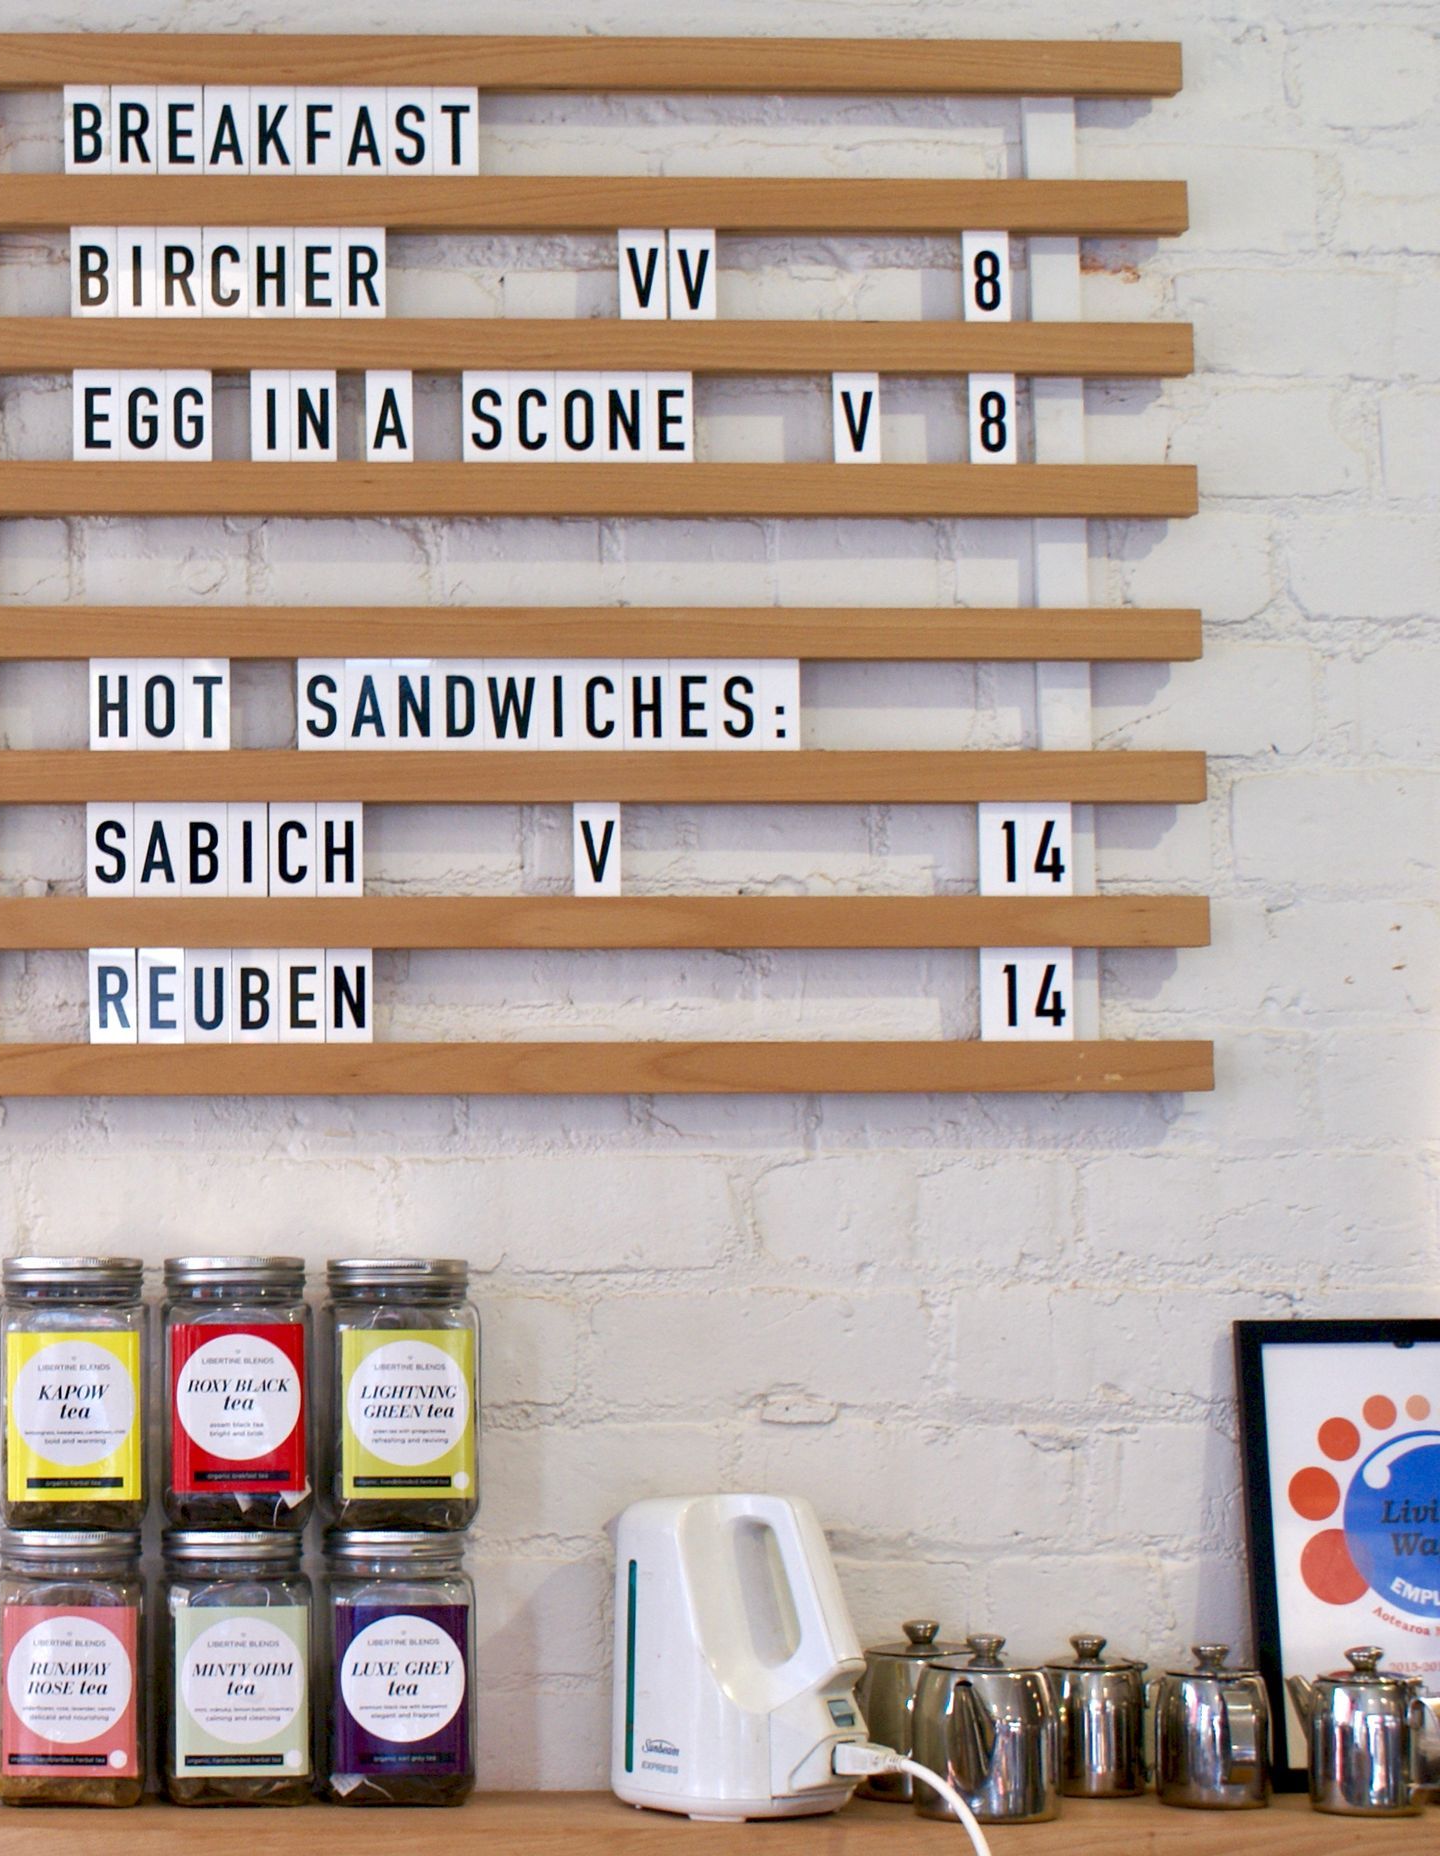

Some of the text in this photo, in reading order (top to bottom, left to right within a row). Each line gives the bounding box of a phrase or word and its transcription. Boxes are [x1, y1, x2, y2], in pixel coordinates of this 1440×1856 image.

[72, 102, 471, 167] BREAKFAST
[79, 244, 1001, 312] BIRCHER VV 8
[84, 386, 1007, 453] EGG IN A SCONE V 8
[98, 674, 786, 739] HOT SANDWICHES:
[95, 820, 1065, 885] SABICH V 14
[97, 963, 1066, 1031] REUBEN 14
[38, 1384, 109, 1401] KAPOW
[187, 1379, 290, 1392] ROXY BLACK
[361, 1385, 457, 1399] LIGHTNING
[224, 1396, 254, 1411] tea
[364, 1404, 455, 1418] GREEN tea
[60, 1404, 91, 1419] tea
[1381, 1498, 1440, 1524] Livi
[1391, 1532, 1440, 1558] Wa
[1372, 1606, 1430, 1636] Aotearoa
[30, 1662, 110, 1676] RUNAWAY
[192, 1662, 293, 1677] MINTY OHM
[352, 1661, 454, 1676] LUXE GREY
[28, 1681, 108, 1695] ROSE tea
[227, 1682, 255, 1696] tea
[388, 1681, 419, 1696] tea
[641, 1738, 680, 1757] Sunbeam
[641, 1760, 679, 1774] EXPRESS
